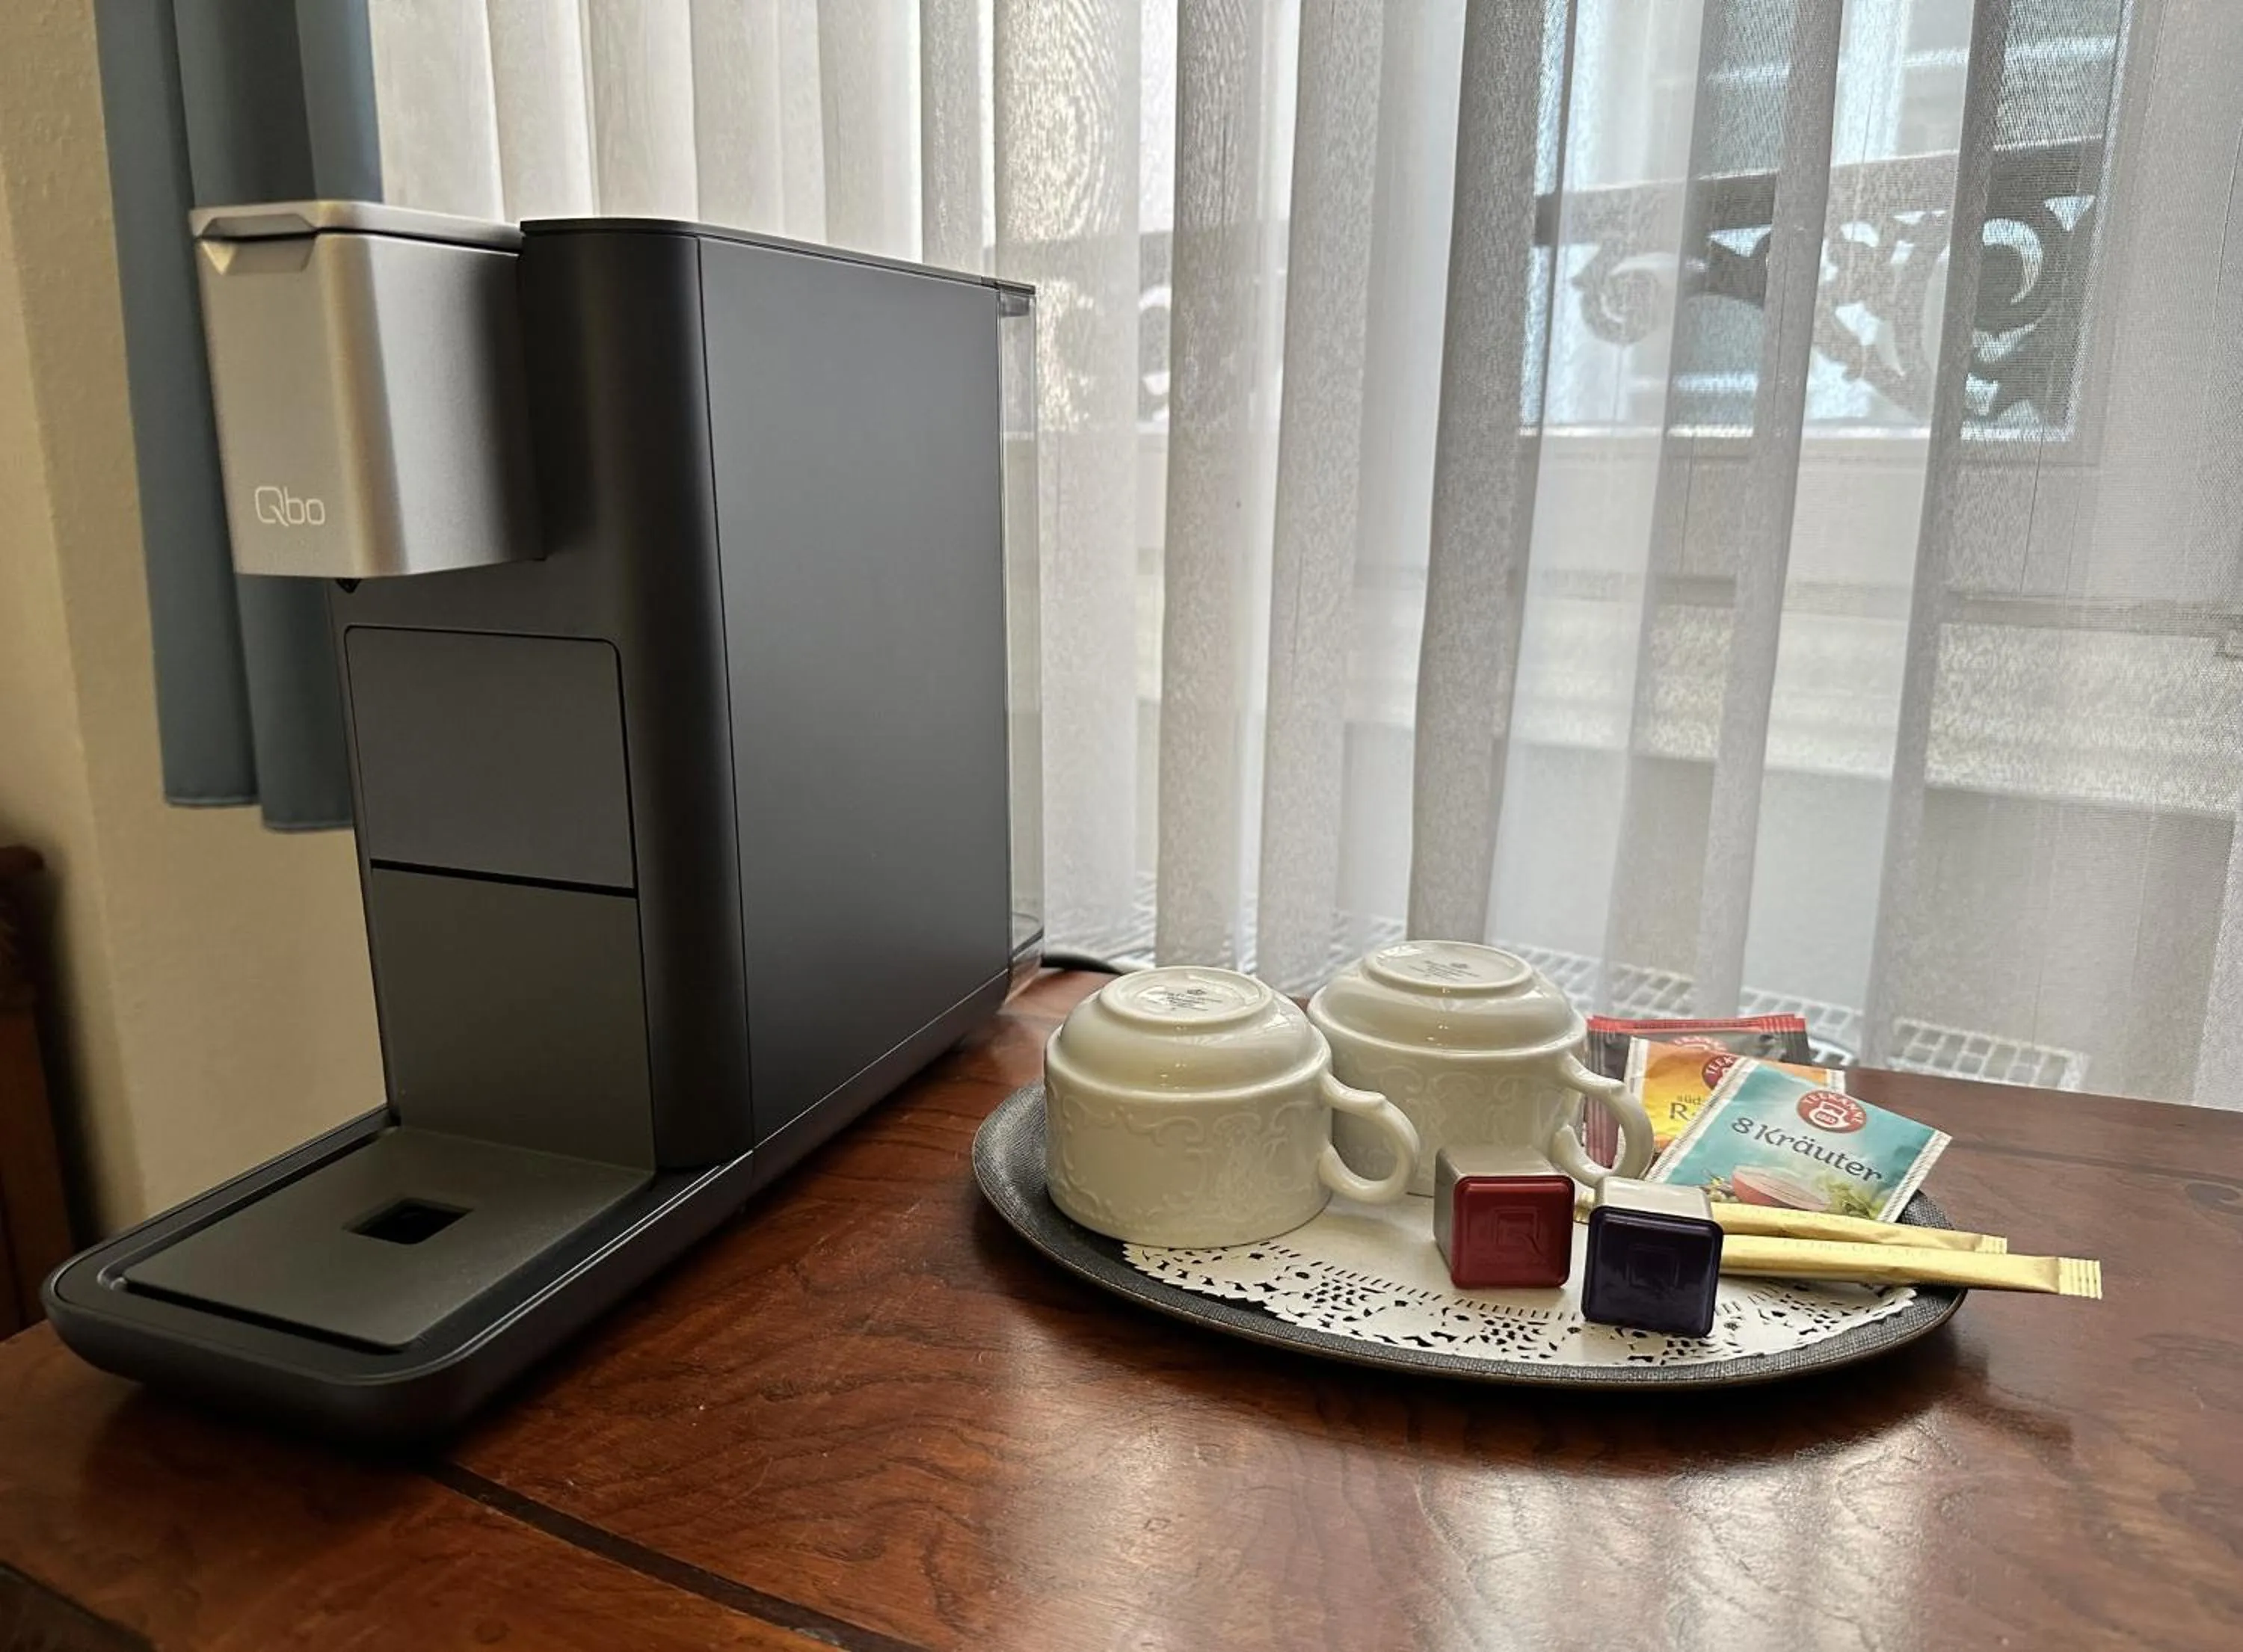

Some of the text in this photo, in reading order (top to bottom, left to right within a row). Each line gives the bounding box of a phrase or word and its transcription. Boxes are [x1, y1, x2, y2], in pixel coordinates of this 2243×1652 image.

[255, 487, 325, 527] Qbo
[1670, 1103, 1696, 1121] R
[1732, 1118, 1883, 1181] 8 Kräuter
